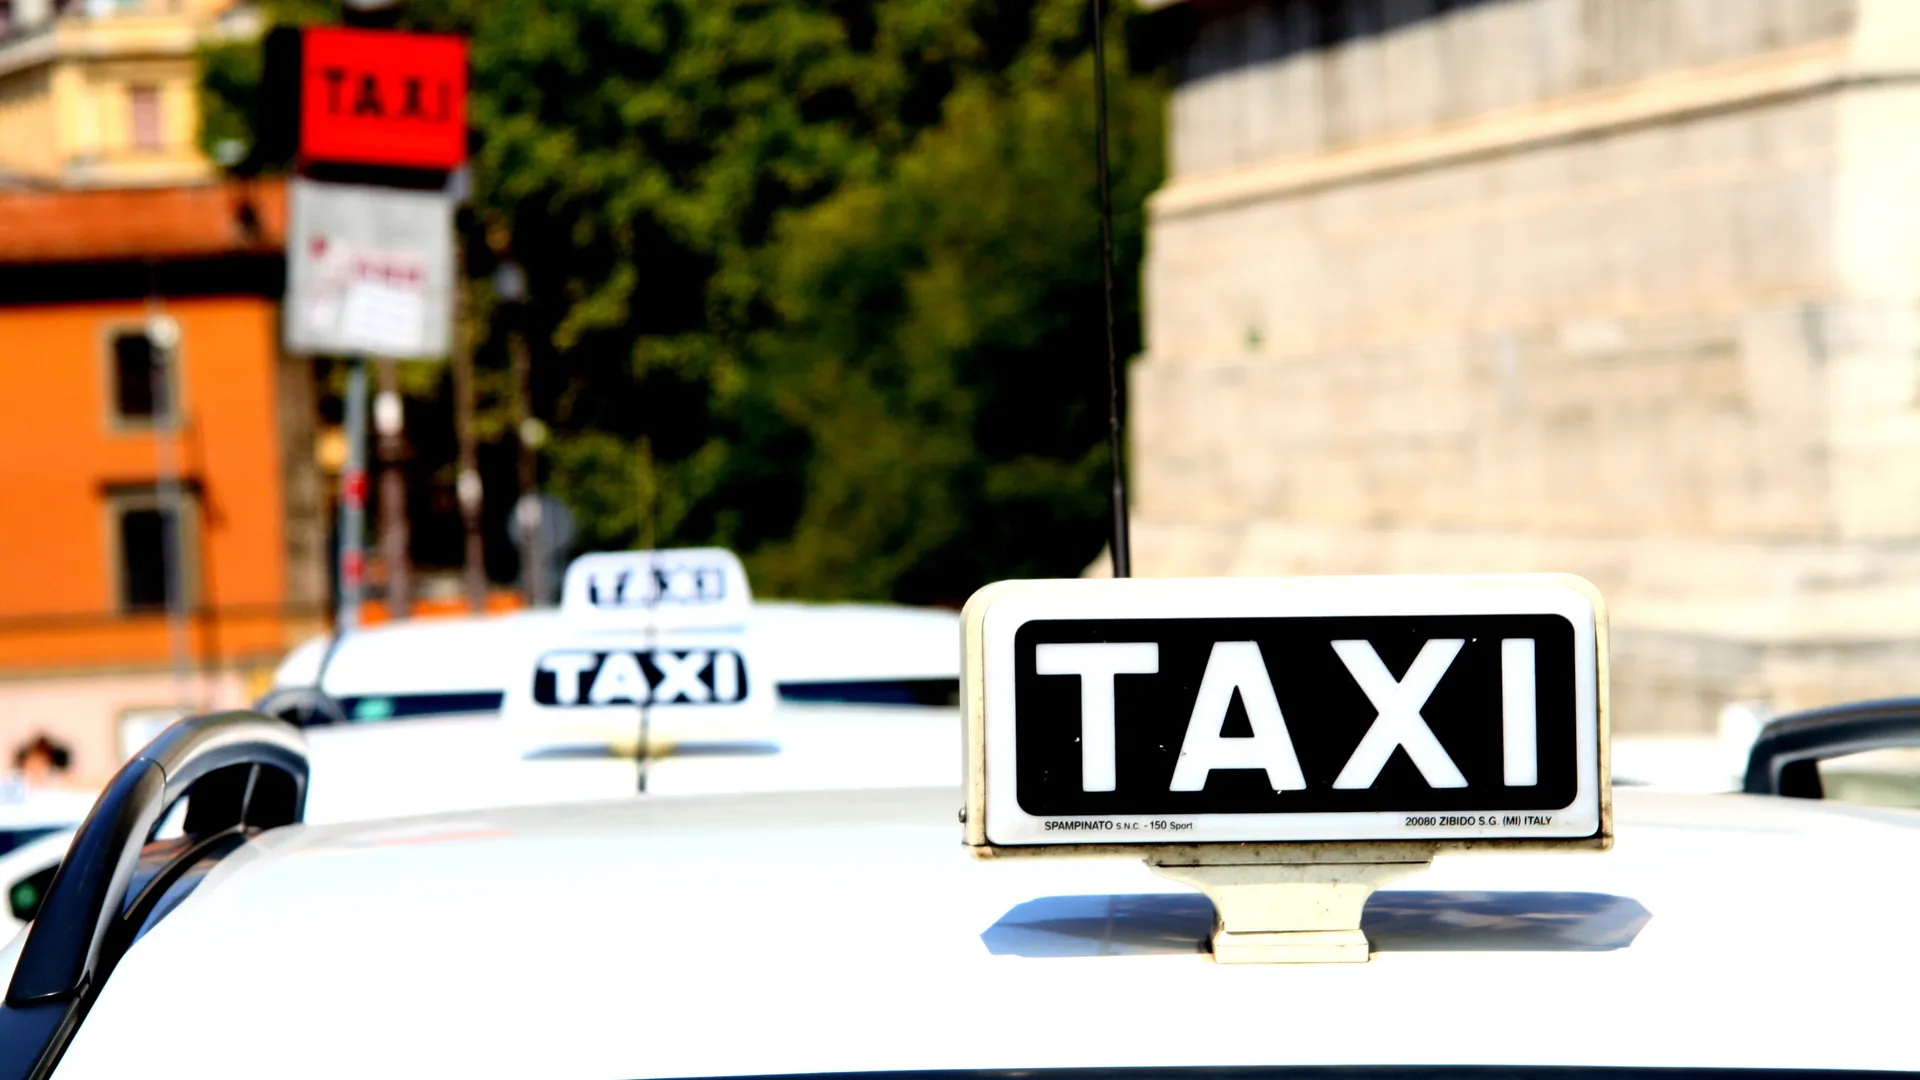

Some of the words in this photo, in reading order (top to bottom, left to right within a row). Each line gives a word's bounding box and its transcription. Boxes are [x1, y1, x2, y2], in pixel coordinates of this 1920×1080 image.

[323, 67, 452, 122] TAXI
[539, 650, 740, 704] TAXI
[1036, 638, 1538, 793] TAXI
[1044, 820, 1114, 831] SPAMPINATO
[1169, 821, 1194, 831] Sport
[1405, 816, 1437, 827] 20080
[1438, 816, 1476, 826] ZIBIDO
[1478, 816, 1500, 826] S.G.
[1502, 816, 1522, 827] (MI)
[1524, 816, 1553, 826] ITALY
